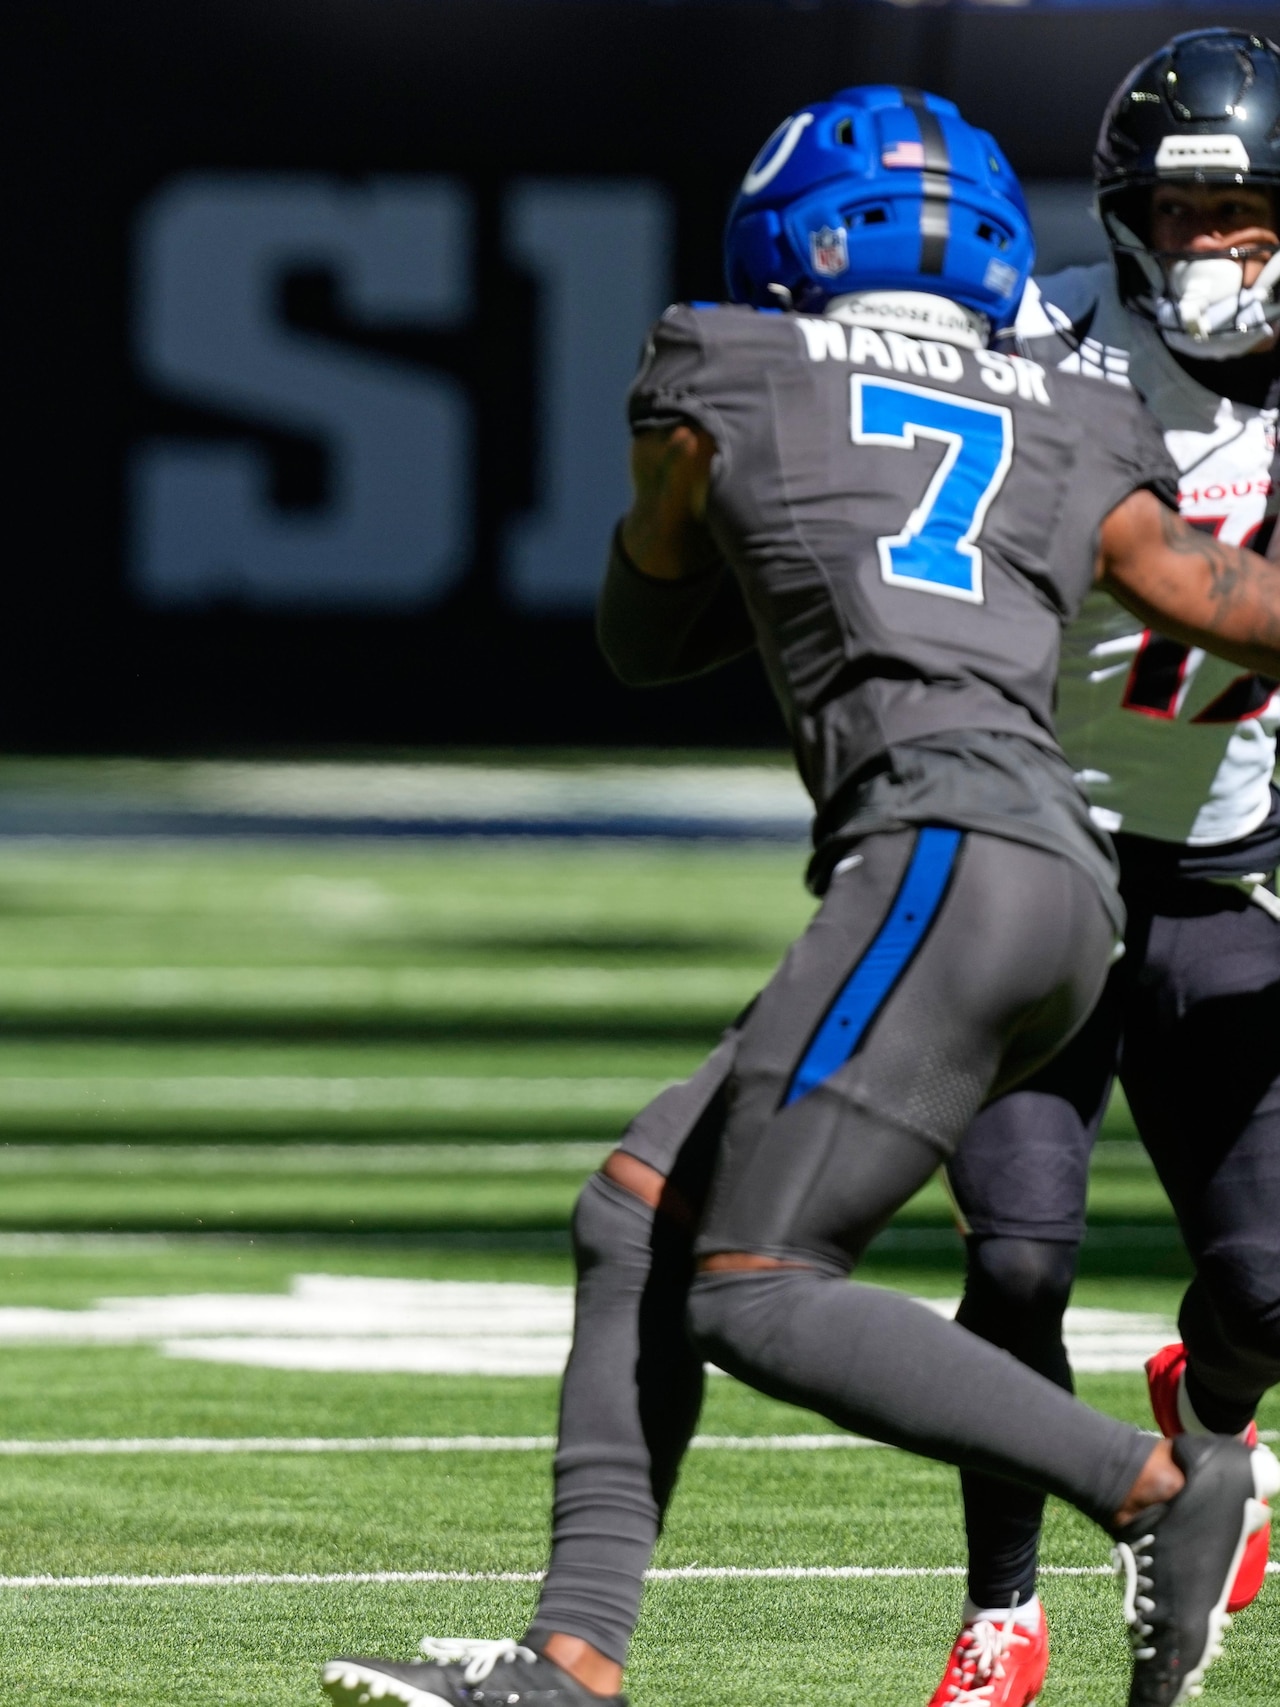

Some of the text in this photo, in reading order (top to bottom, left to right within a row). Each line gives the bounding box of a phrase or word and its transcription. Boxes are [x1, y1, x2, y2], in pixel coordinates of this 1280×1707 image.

[850, 301, 930, 323] CHOOSE
[796, 317, 964, 383] WARD
[850, 372, 1014, 605] 7
